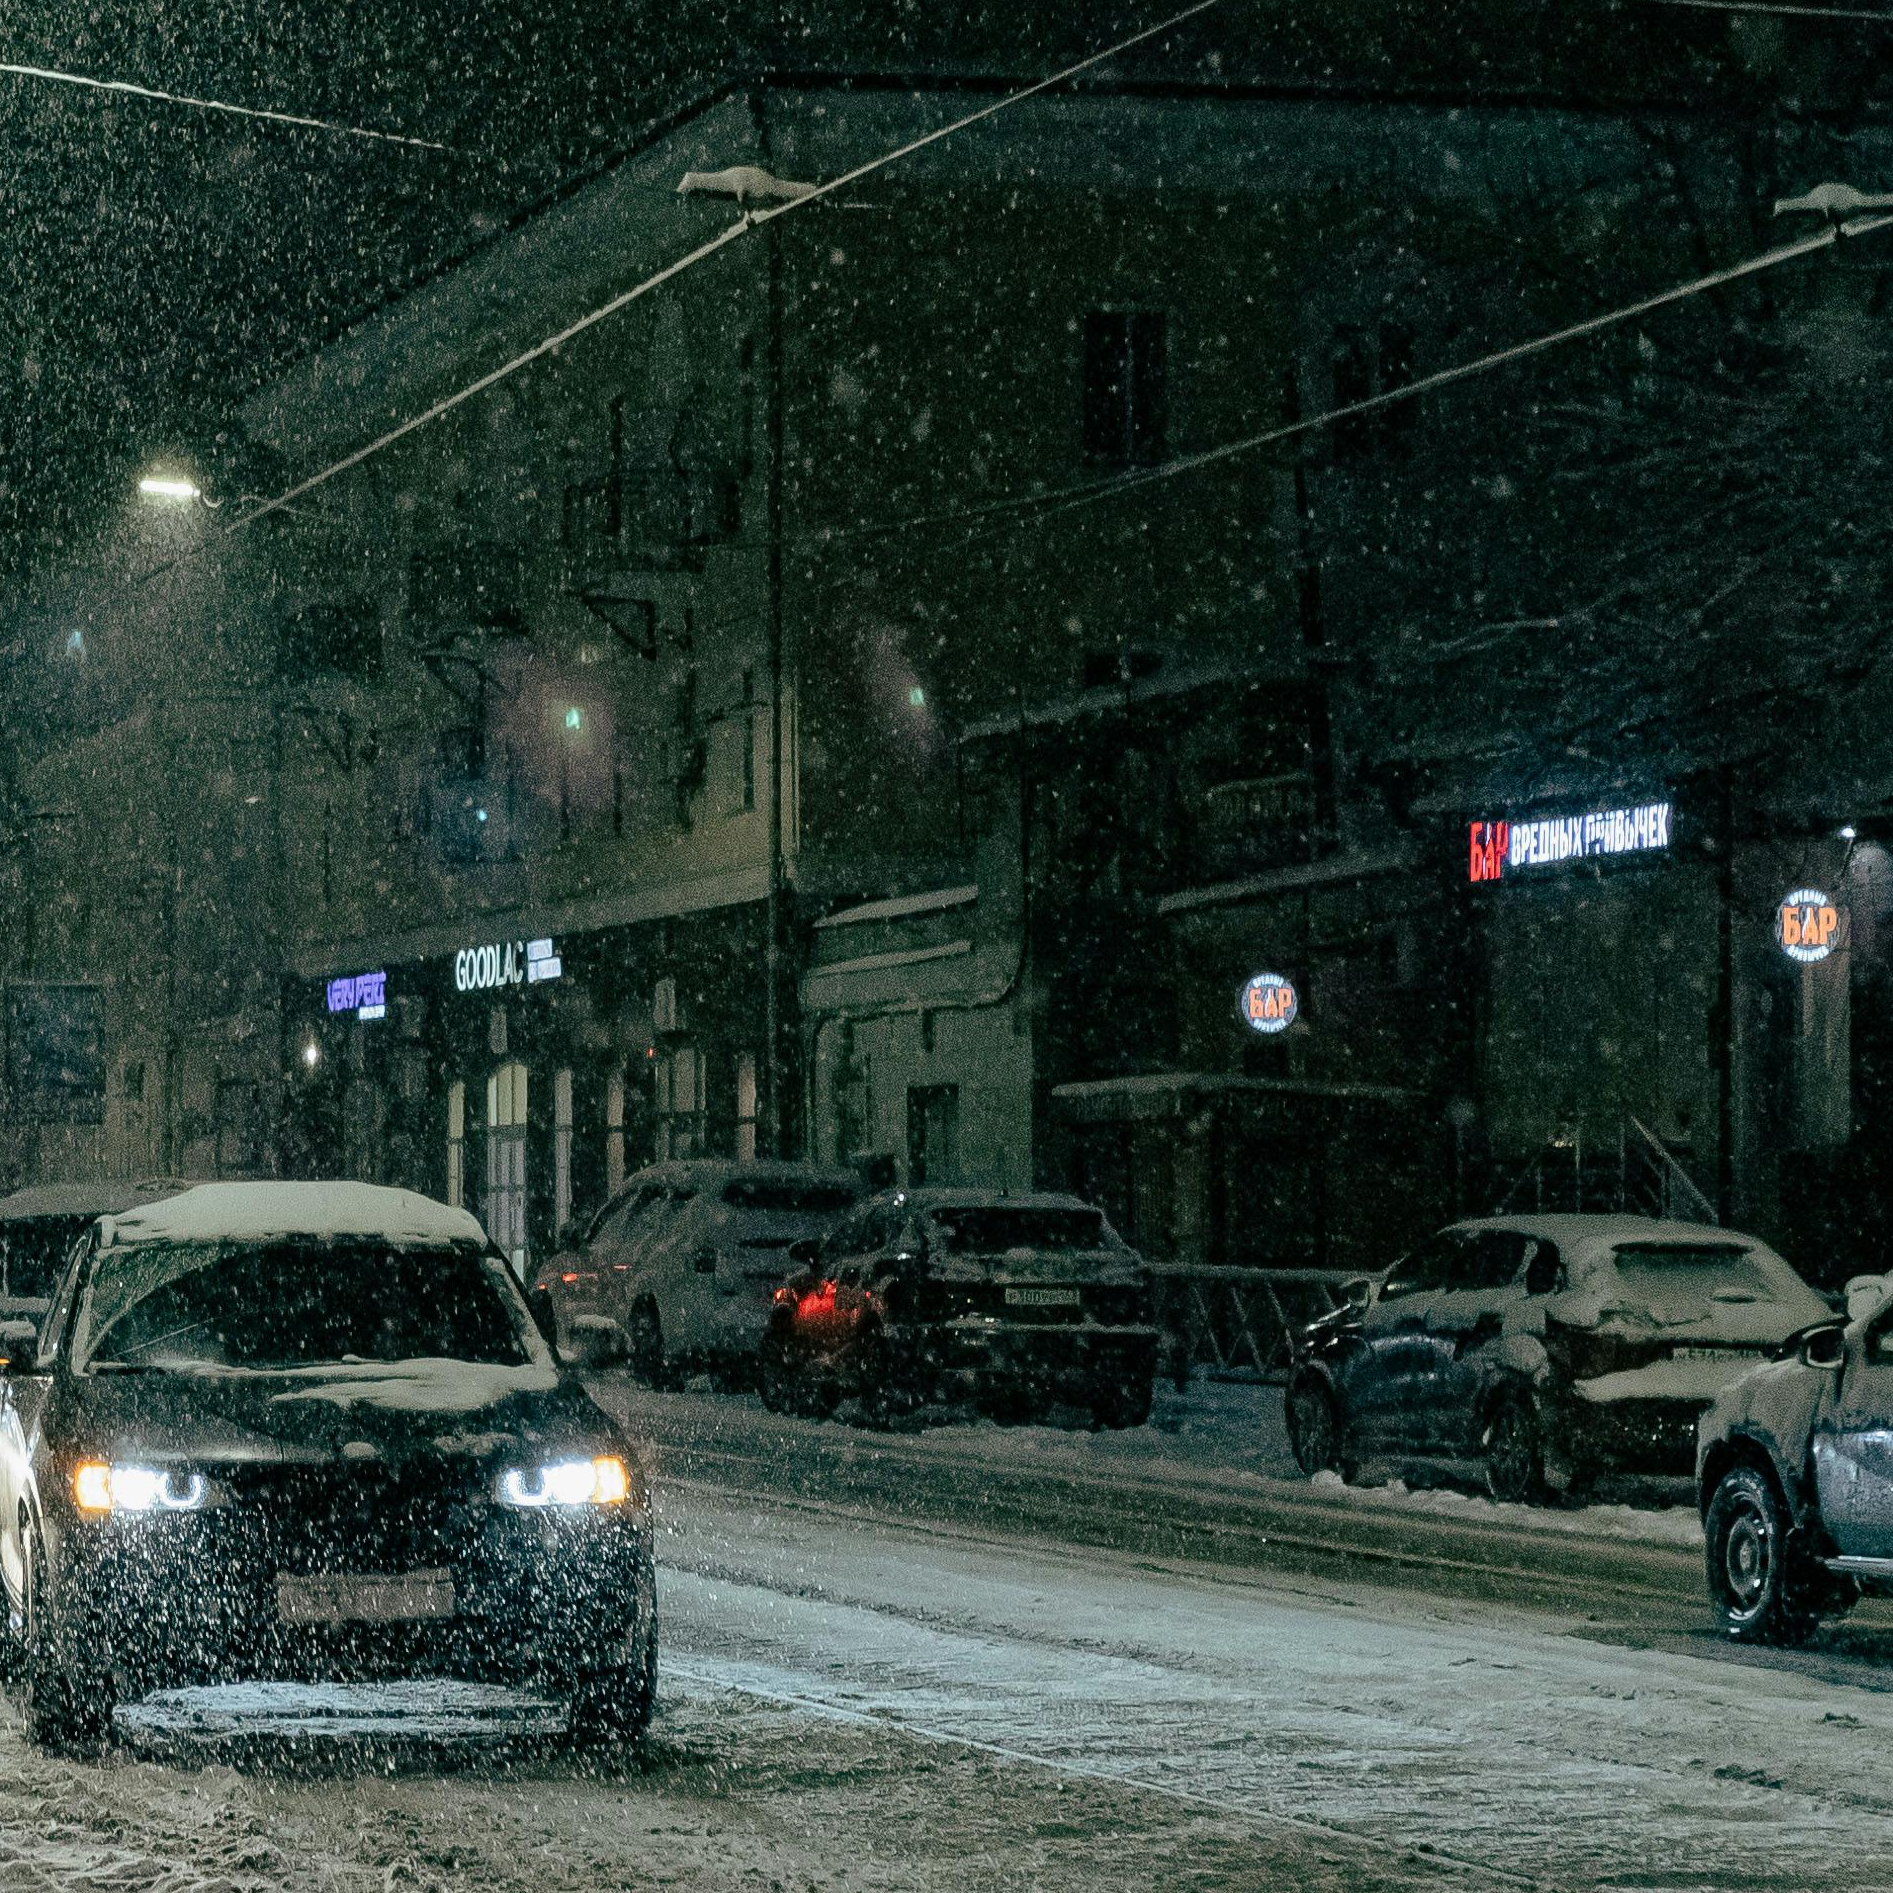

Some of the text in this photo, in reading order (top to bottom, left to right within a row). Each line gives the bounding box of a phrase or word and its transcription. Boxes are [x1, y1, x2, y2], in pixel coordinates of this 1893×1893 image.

[1470, 803, 1669, 883] БАР ВРЕДНЫХ ПРИВЫЧЕК
[1784, 907, 1837, 945] БАР
[456, 940, 524, 992] GOODLAC
[1249, 988, 1292, 1018] БАР
